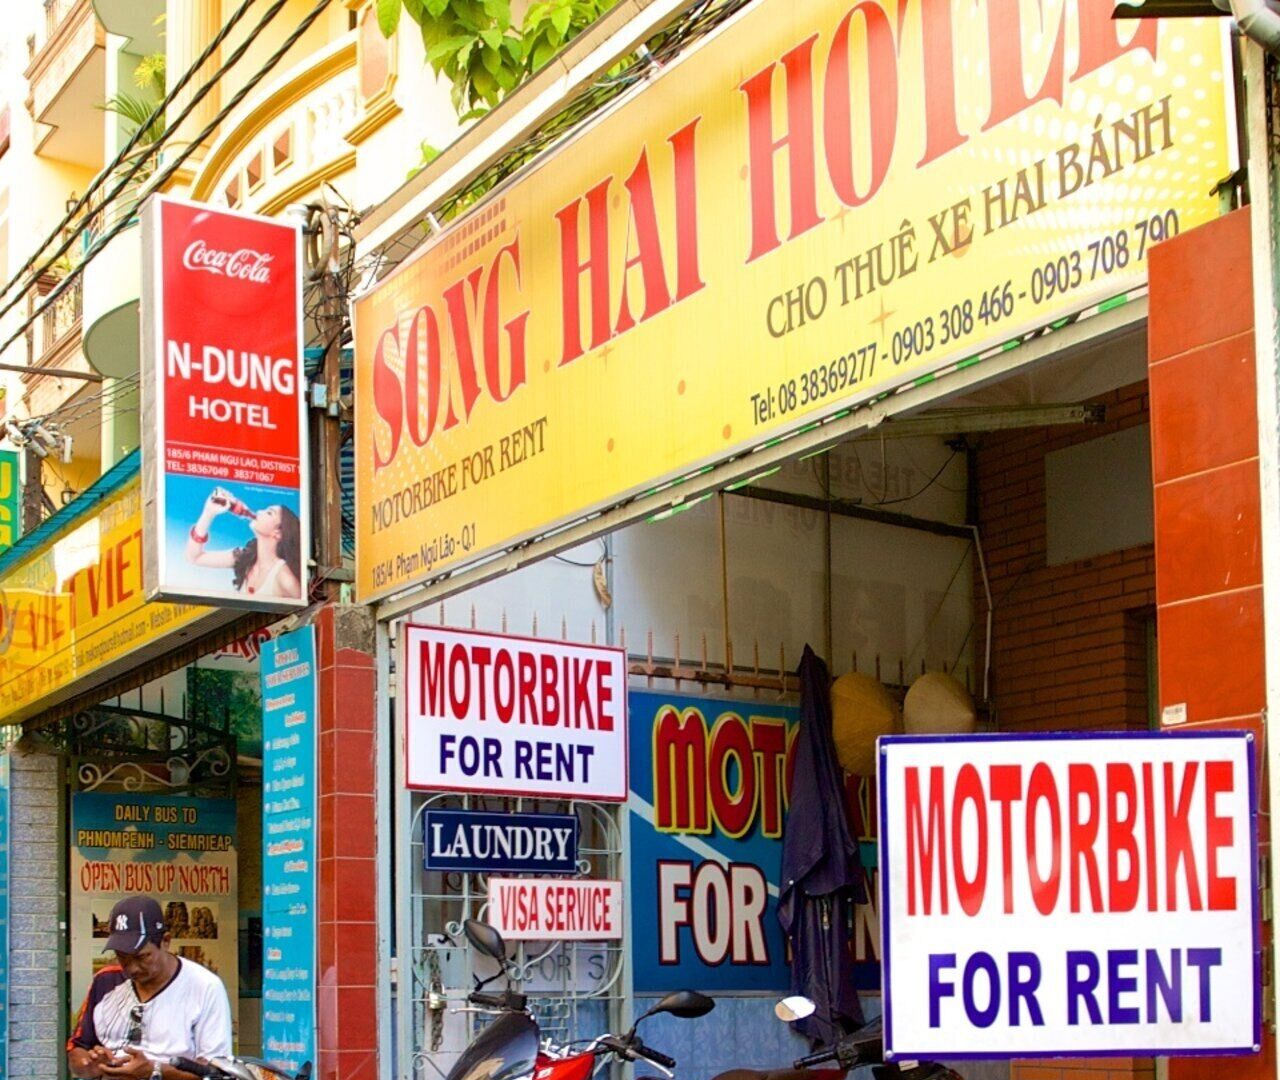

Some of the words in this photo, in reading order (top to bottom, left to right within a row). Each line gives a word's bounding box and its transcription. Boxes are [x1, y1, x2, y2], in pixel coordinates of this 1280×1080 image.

[767, 274, 828, 339] CHO
[834, 218, 919, 307] THUÊ
[926, 198, 976, 264] XE
[981, 158, 1048, 236] HAI
[1055, 94, 1174, 201] BÁNH
[372, 230, 530, 477] SONG
[553, 116, 707, 368] HAI
[750, 393, 776, 426] Tel:
[778, 387, 797, 413] 08
[800, 341, 878, 407] 38369277
[892, 323, 935, 364] 0903
[939, 303, 974, 345] 308
[976, 279, 1015, 331] 466
[1030, 249, 1082, 304] 0903
[1086, 228, 1130, 282] 708
[167, 340, 295, 396] N-DUNG
[188, 394, 277, 430] HOTEL
[166, 460, 185, 472] TEL:
[192, 451, 218, 463] PHAM
[219, 454, 239, 466] NGU
[372, 463, 458, 536] MOTORBIKE
[461, 444, 496, 492] FOR
[499, 415, 548, 473] RENT
[419, 639, 614, 732] MOTORBIKE
[439, 733, 504, 779] FOR
[514, 740, 595, 784] RENT
[77, 830, 154, 849] PHNOMPENH
[115, 804, 150, 822] DAILY
[154, 805, 177, 823] BUS
[182, 807, 197, 824] TO
[904, 760, 1238, 918] MOTORBIKE
[430, 823, 573, 861] LAUNDRY
[80, 861, 121, 892] OPEN
[124, 863, 153, 893] BUS
[156, 865, 175, 893] UP
[178, 865, 230, 895] NORTH
[499, 884, 540, 932] VISA
[544, 886, 613, 933] SERVICE
[656, 858, 770, 966] FOR
[928, 950, 1046, 1030] FOR
[1065, 947, 1223, 1027] RENT
